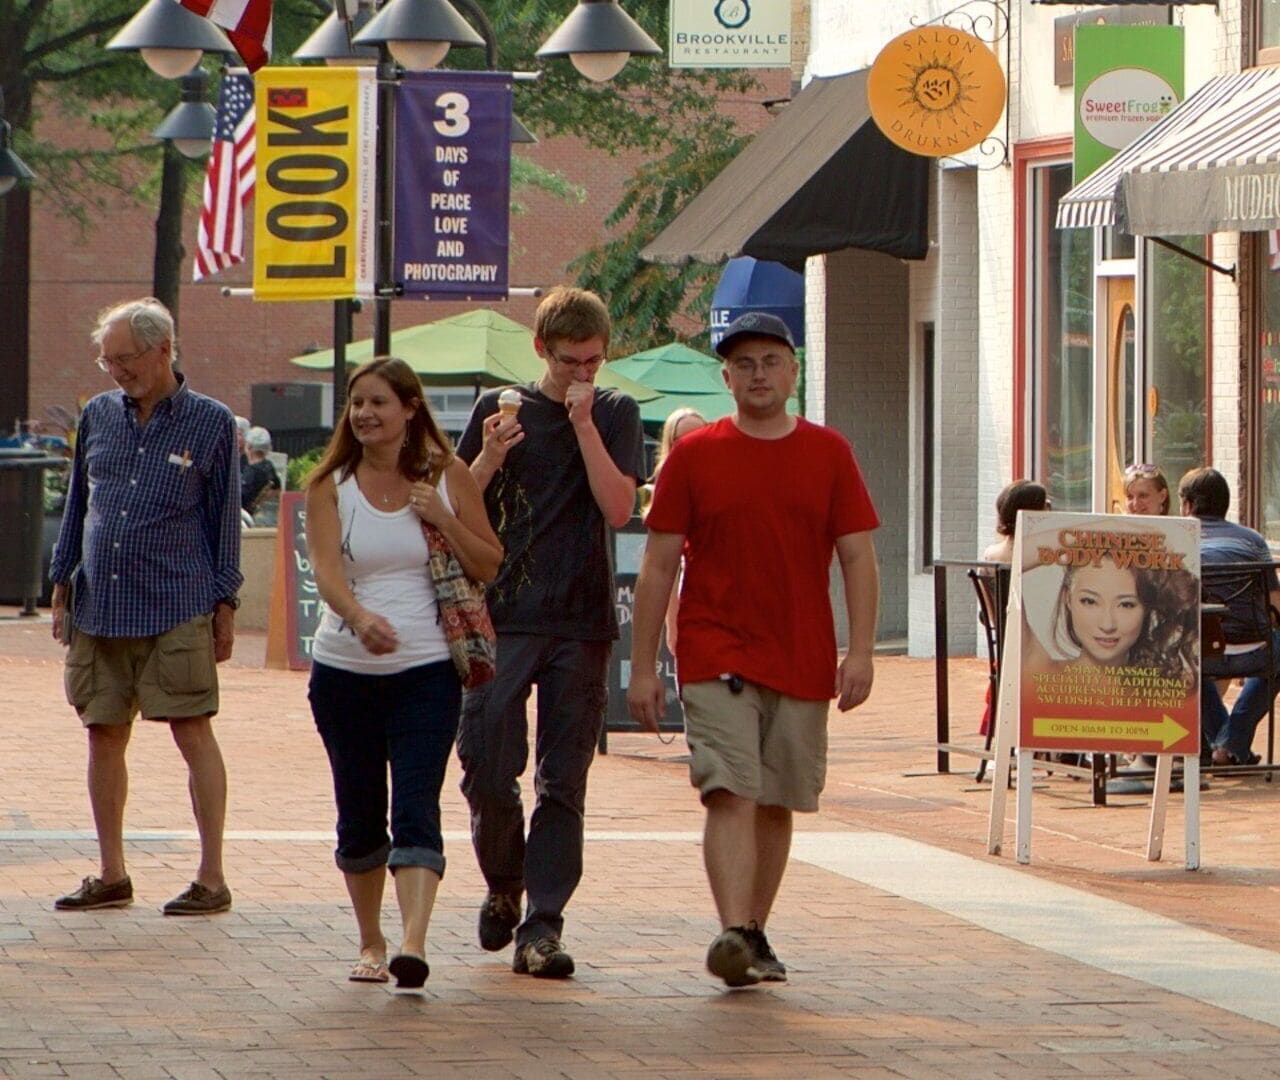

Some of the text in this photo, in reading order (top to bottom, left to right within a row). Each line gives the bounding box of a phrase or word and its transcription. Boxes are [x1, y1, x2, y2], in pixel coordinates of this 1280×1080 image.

[676, 32, 788, 45] BROOKVILLE
[903, 31, 976, 54] SALON
[684, 47, 780, 55] RESTAURANT
[433, 91, 471, 137] 3
[891, 120, 983, 148] DRUKNYA
[435, 146, 468, 164] DAYS
[443, 170, 461, 187] OF
[431, 193, 471, 211] PEACE
[434, 217, 468, 235] LOVE
[437, 241, 464, 258] AND
[404, 263, 498, 282] PHOTOGRAPHY
[1058, 529, 1167, 551] CHINESE
[1037, 546, 1186, 570] BODY WORK
[1064, 665, 1161, 677] ASIAN MASSAGE
[1106, 676, 1188, 688] TRADITIONAL
[1037, 695, 1093, 706] SWEDISH
[1111, 697, 1142, 707] DEEP
[1147, 698, 1185, 709] TISSUE
[1143, 689, 1186, 698] HANDS
[1050, 724, 1149, 736] OPEN 10AM TO 10PM
